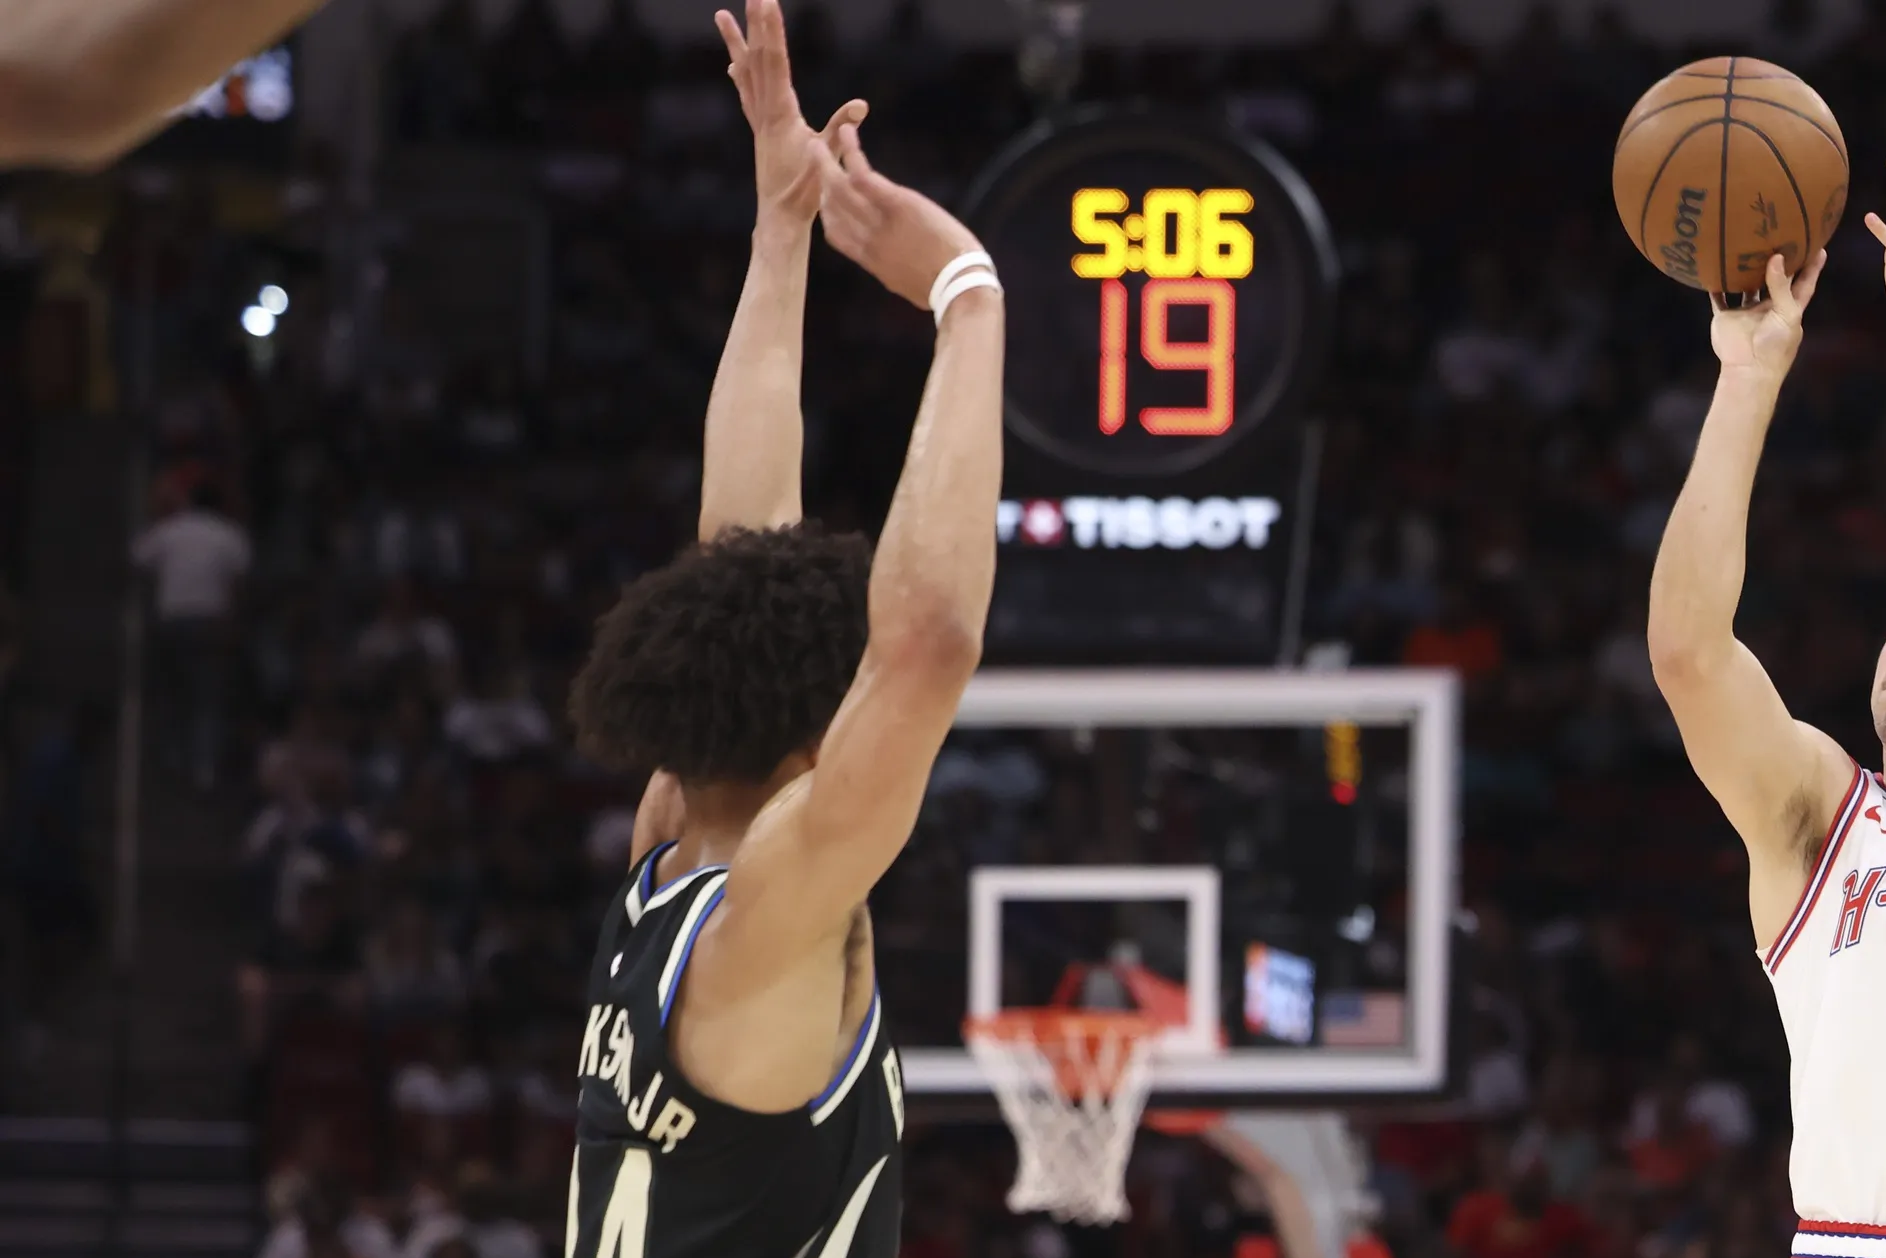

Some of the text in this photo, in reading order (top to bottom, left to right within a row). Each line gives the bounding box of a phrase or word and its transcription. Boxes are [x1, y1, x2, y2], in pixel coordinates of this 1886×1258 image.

[1071, 187, 1254, 279] 5:06
[1099, 277, 1236, 435] 19
[1063, 496, 1281, 549] TISSOT
